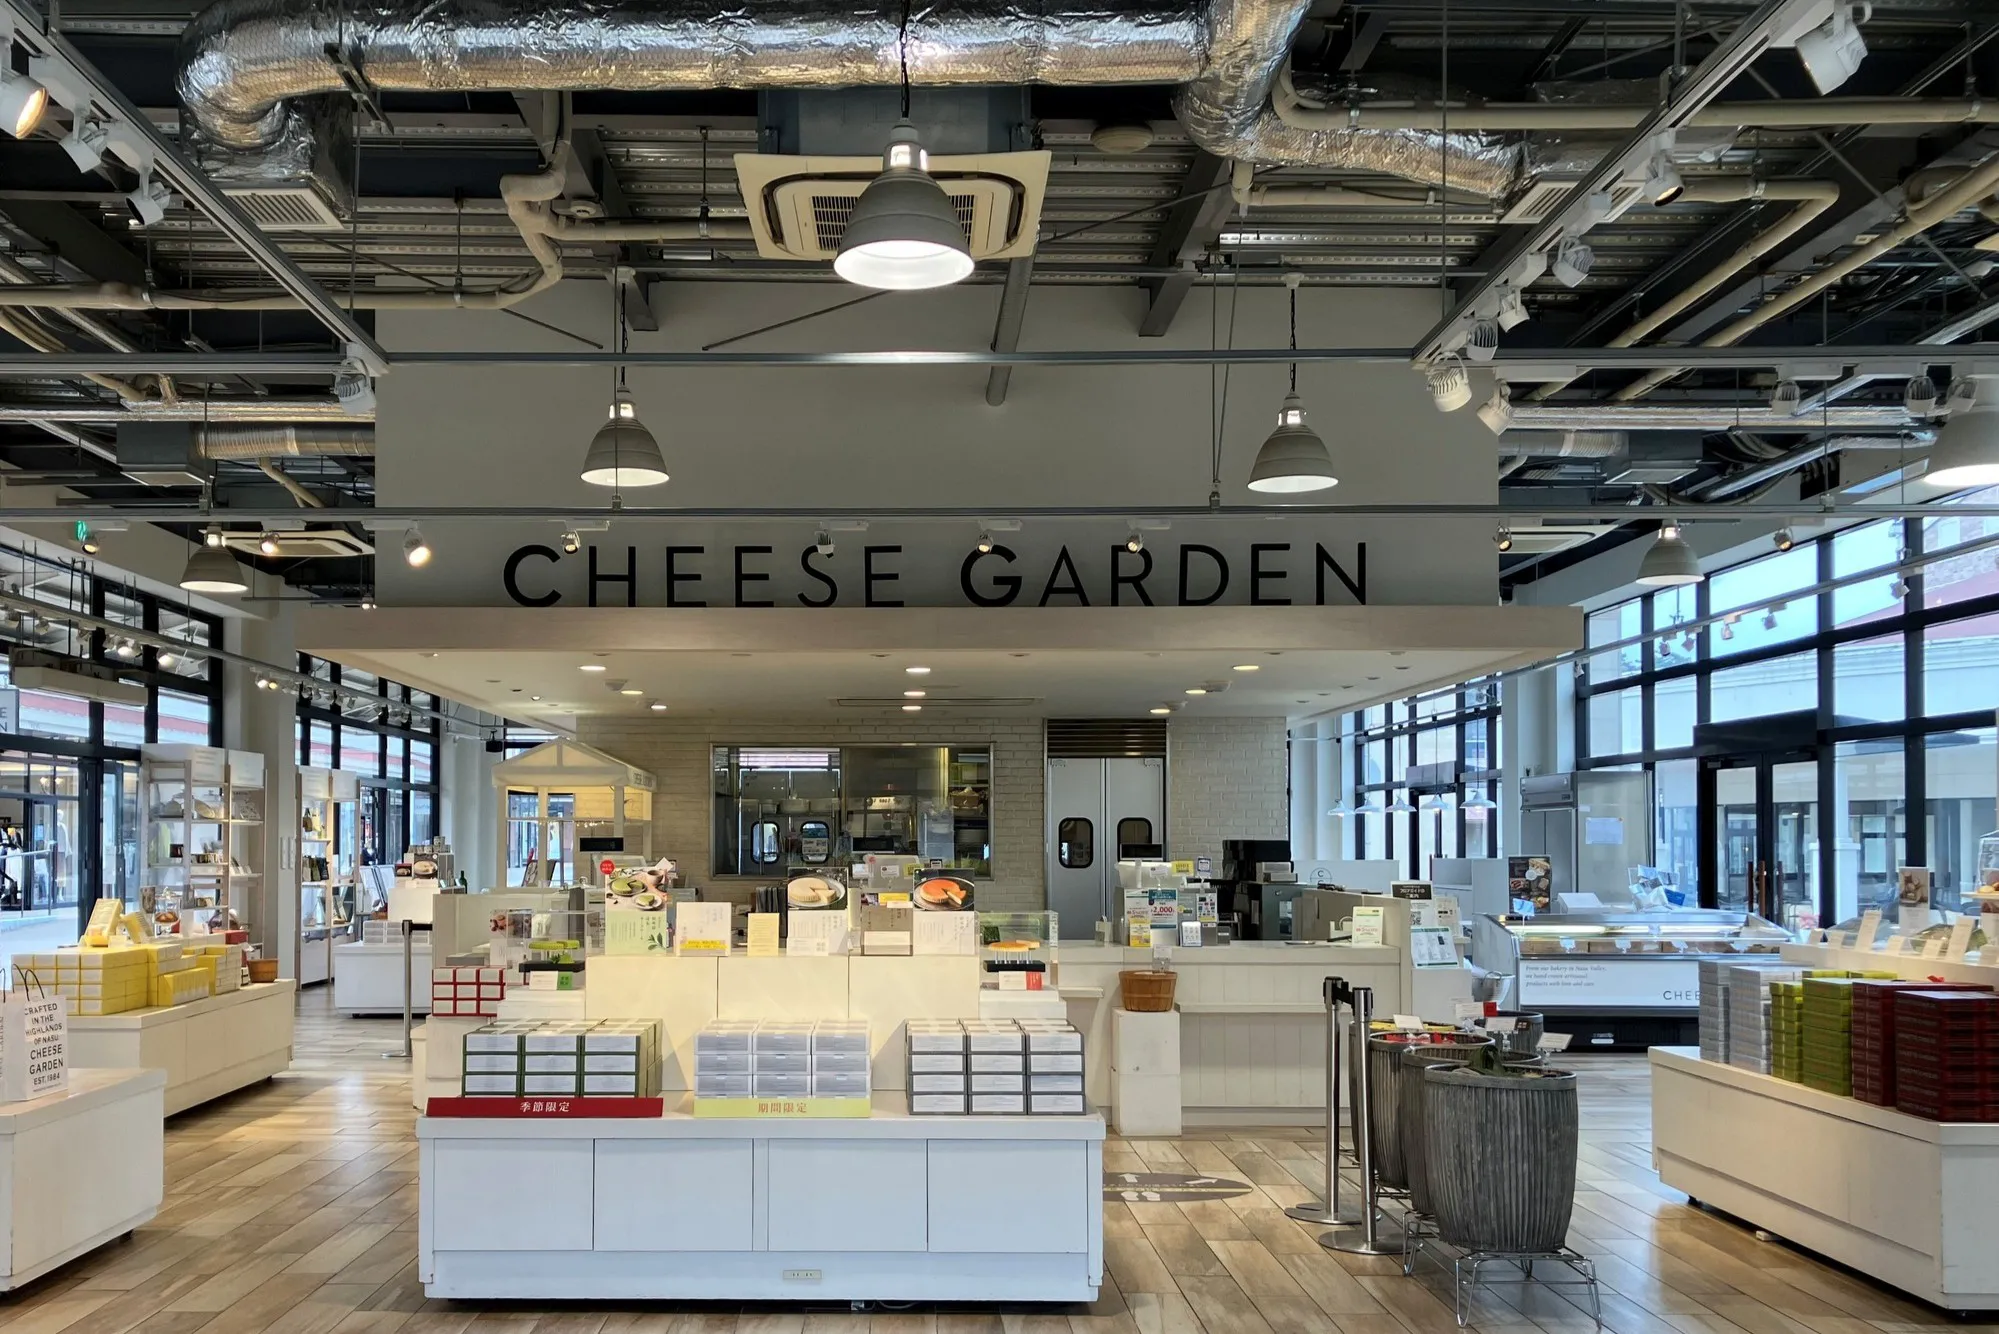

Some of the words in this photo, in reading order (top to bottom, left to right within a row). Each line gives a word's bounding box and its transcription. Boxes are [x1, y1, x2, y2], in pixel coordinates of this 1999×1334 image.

[503, 544, 905, 607] CHEESE
[960, 542, 1367, 607] GARDEN
[24, 1003, 58, 1015] CRAFTED
[31, 1017, 40, 1025] IN
[40, 1014, 54, 1023] THE
[25, 1023, 63, 1037] HIGHLANDS
[33, 1036, 41, 1045] OF
[42, 1034, 59, 1044] NASU
[30, 1044, 63, 1060] CHEESE
[29, 1059, 64, 1074] GARDEN
[519, 1101, 571, 1113] 季節限定
[757, 1101, 808, 1114] 期間限定
